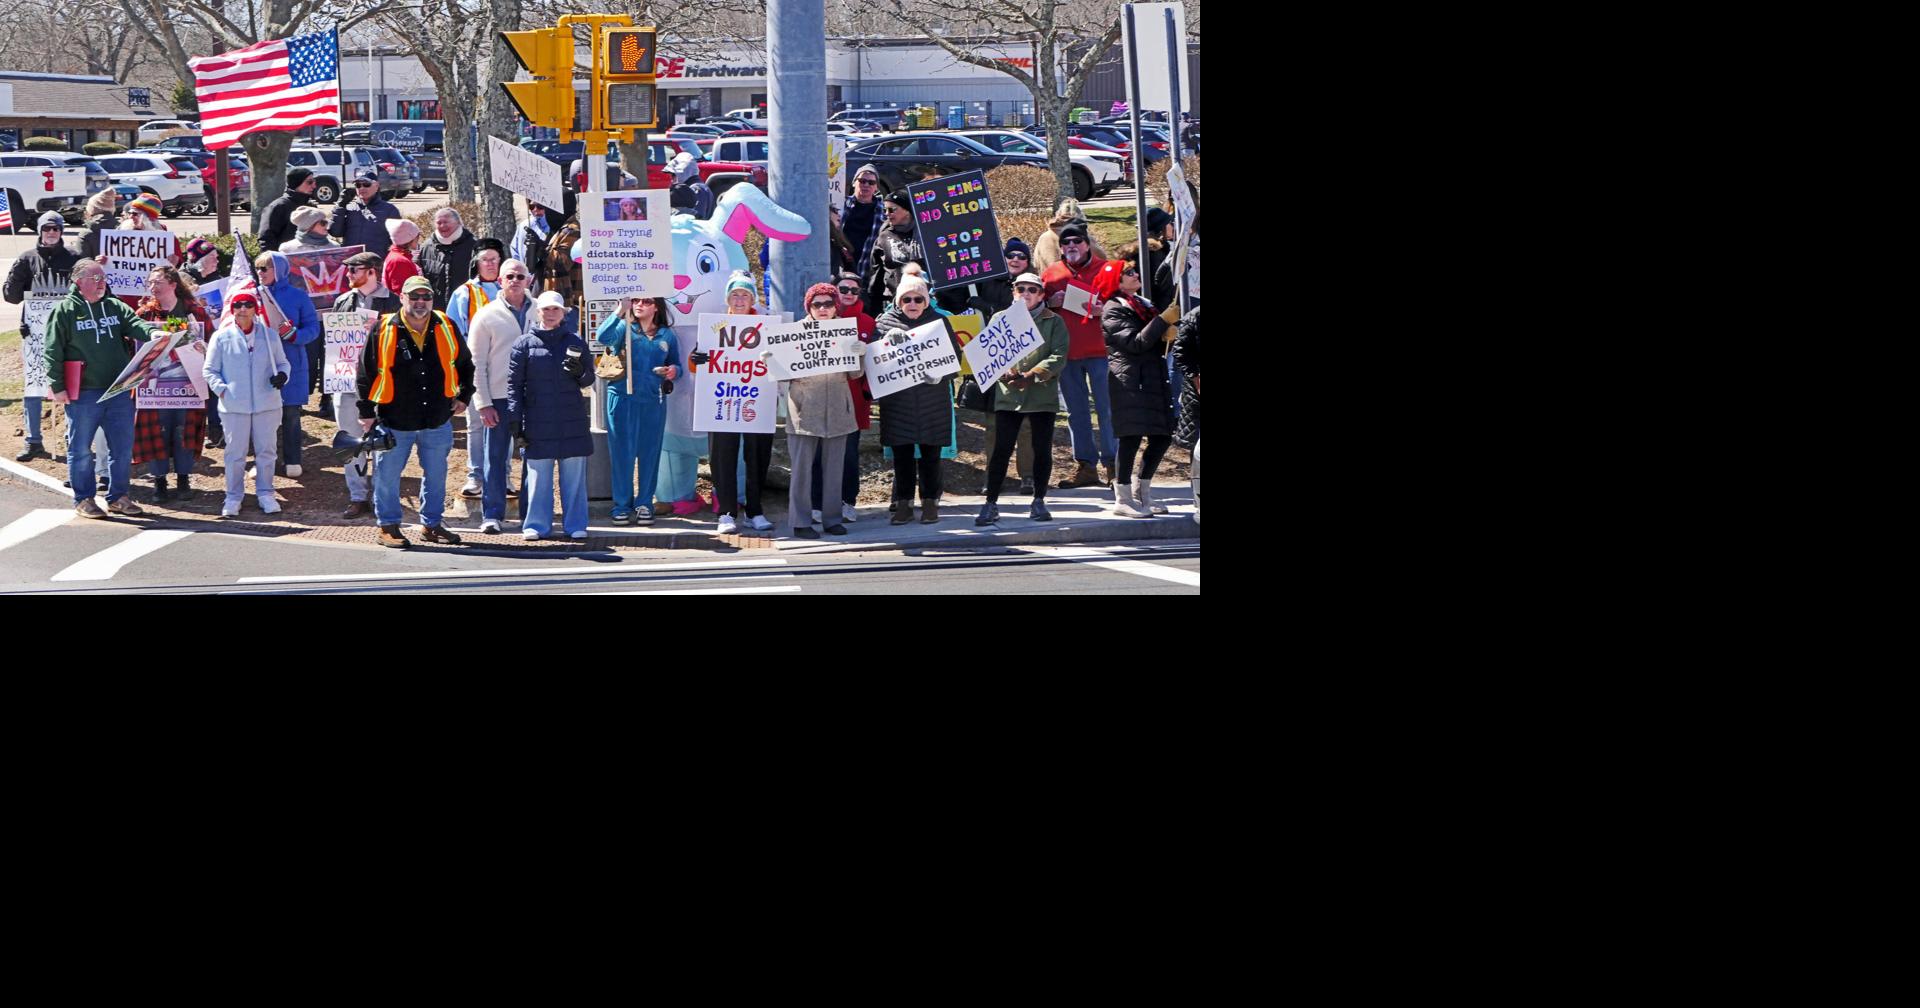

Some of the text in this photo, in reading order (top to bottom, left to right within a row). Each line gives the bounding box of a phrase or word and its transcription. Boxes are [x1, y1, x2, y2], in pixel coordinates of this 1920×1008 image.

[656, 57, 685, 78] CE
[914, 180, 982, 204] NO KING
[920, 198, 989, 223] NO FELON
[590, 228, 653, 238] Stop Trying
[936, 229, 983, 248] STOP
[104, 235, 167, 259] IMPEACH
[590, 240, 638, 249] to make
[587, 250, 655, 259] dictatorship
[947, 246, 981, 263] THE
[112, 261, 156, 272] TRUMP
[587, 262, 629, 272] happen.
[651, 262, 669, 271] not
[946, 260, 992, 280] HATE
[106, 273, 131, 286] SAVE
[592, 274, 637, 283] going to
[603, 285, 645, 295] happen.
[29, 301, 53, 311] GIVE
[76, 315, 121, 331] RED SOX
[326, 314, 368, 327] GREEN
[803, 321, 820, 330] WE
[767, 328, 858, 345] DEMONSTRATORS
[980, 315, 1010, 348] SAVE
[800, 340, 831, 352] LOVE
[988, 329, 1016, 357] OUR
[340, 346, 365, 359] NOT
[803, 350, 828, 360] OUR
[873, 338, 940, 364] DEMOCRACY
[977, 328, 1036, 386] DEMOCRACY
[708, 350, 768, 383] Kings
[790, 356, 855, 371] COUNTRY!!!
[897, 353, 921, 366] NOT
[877, 354, 956, 384] DICTATORSHIP
[140, 387, 171, 396] RENEE
[714, 381, 759, 398] Since
